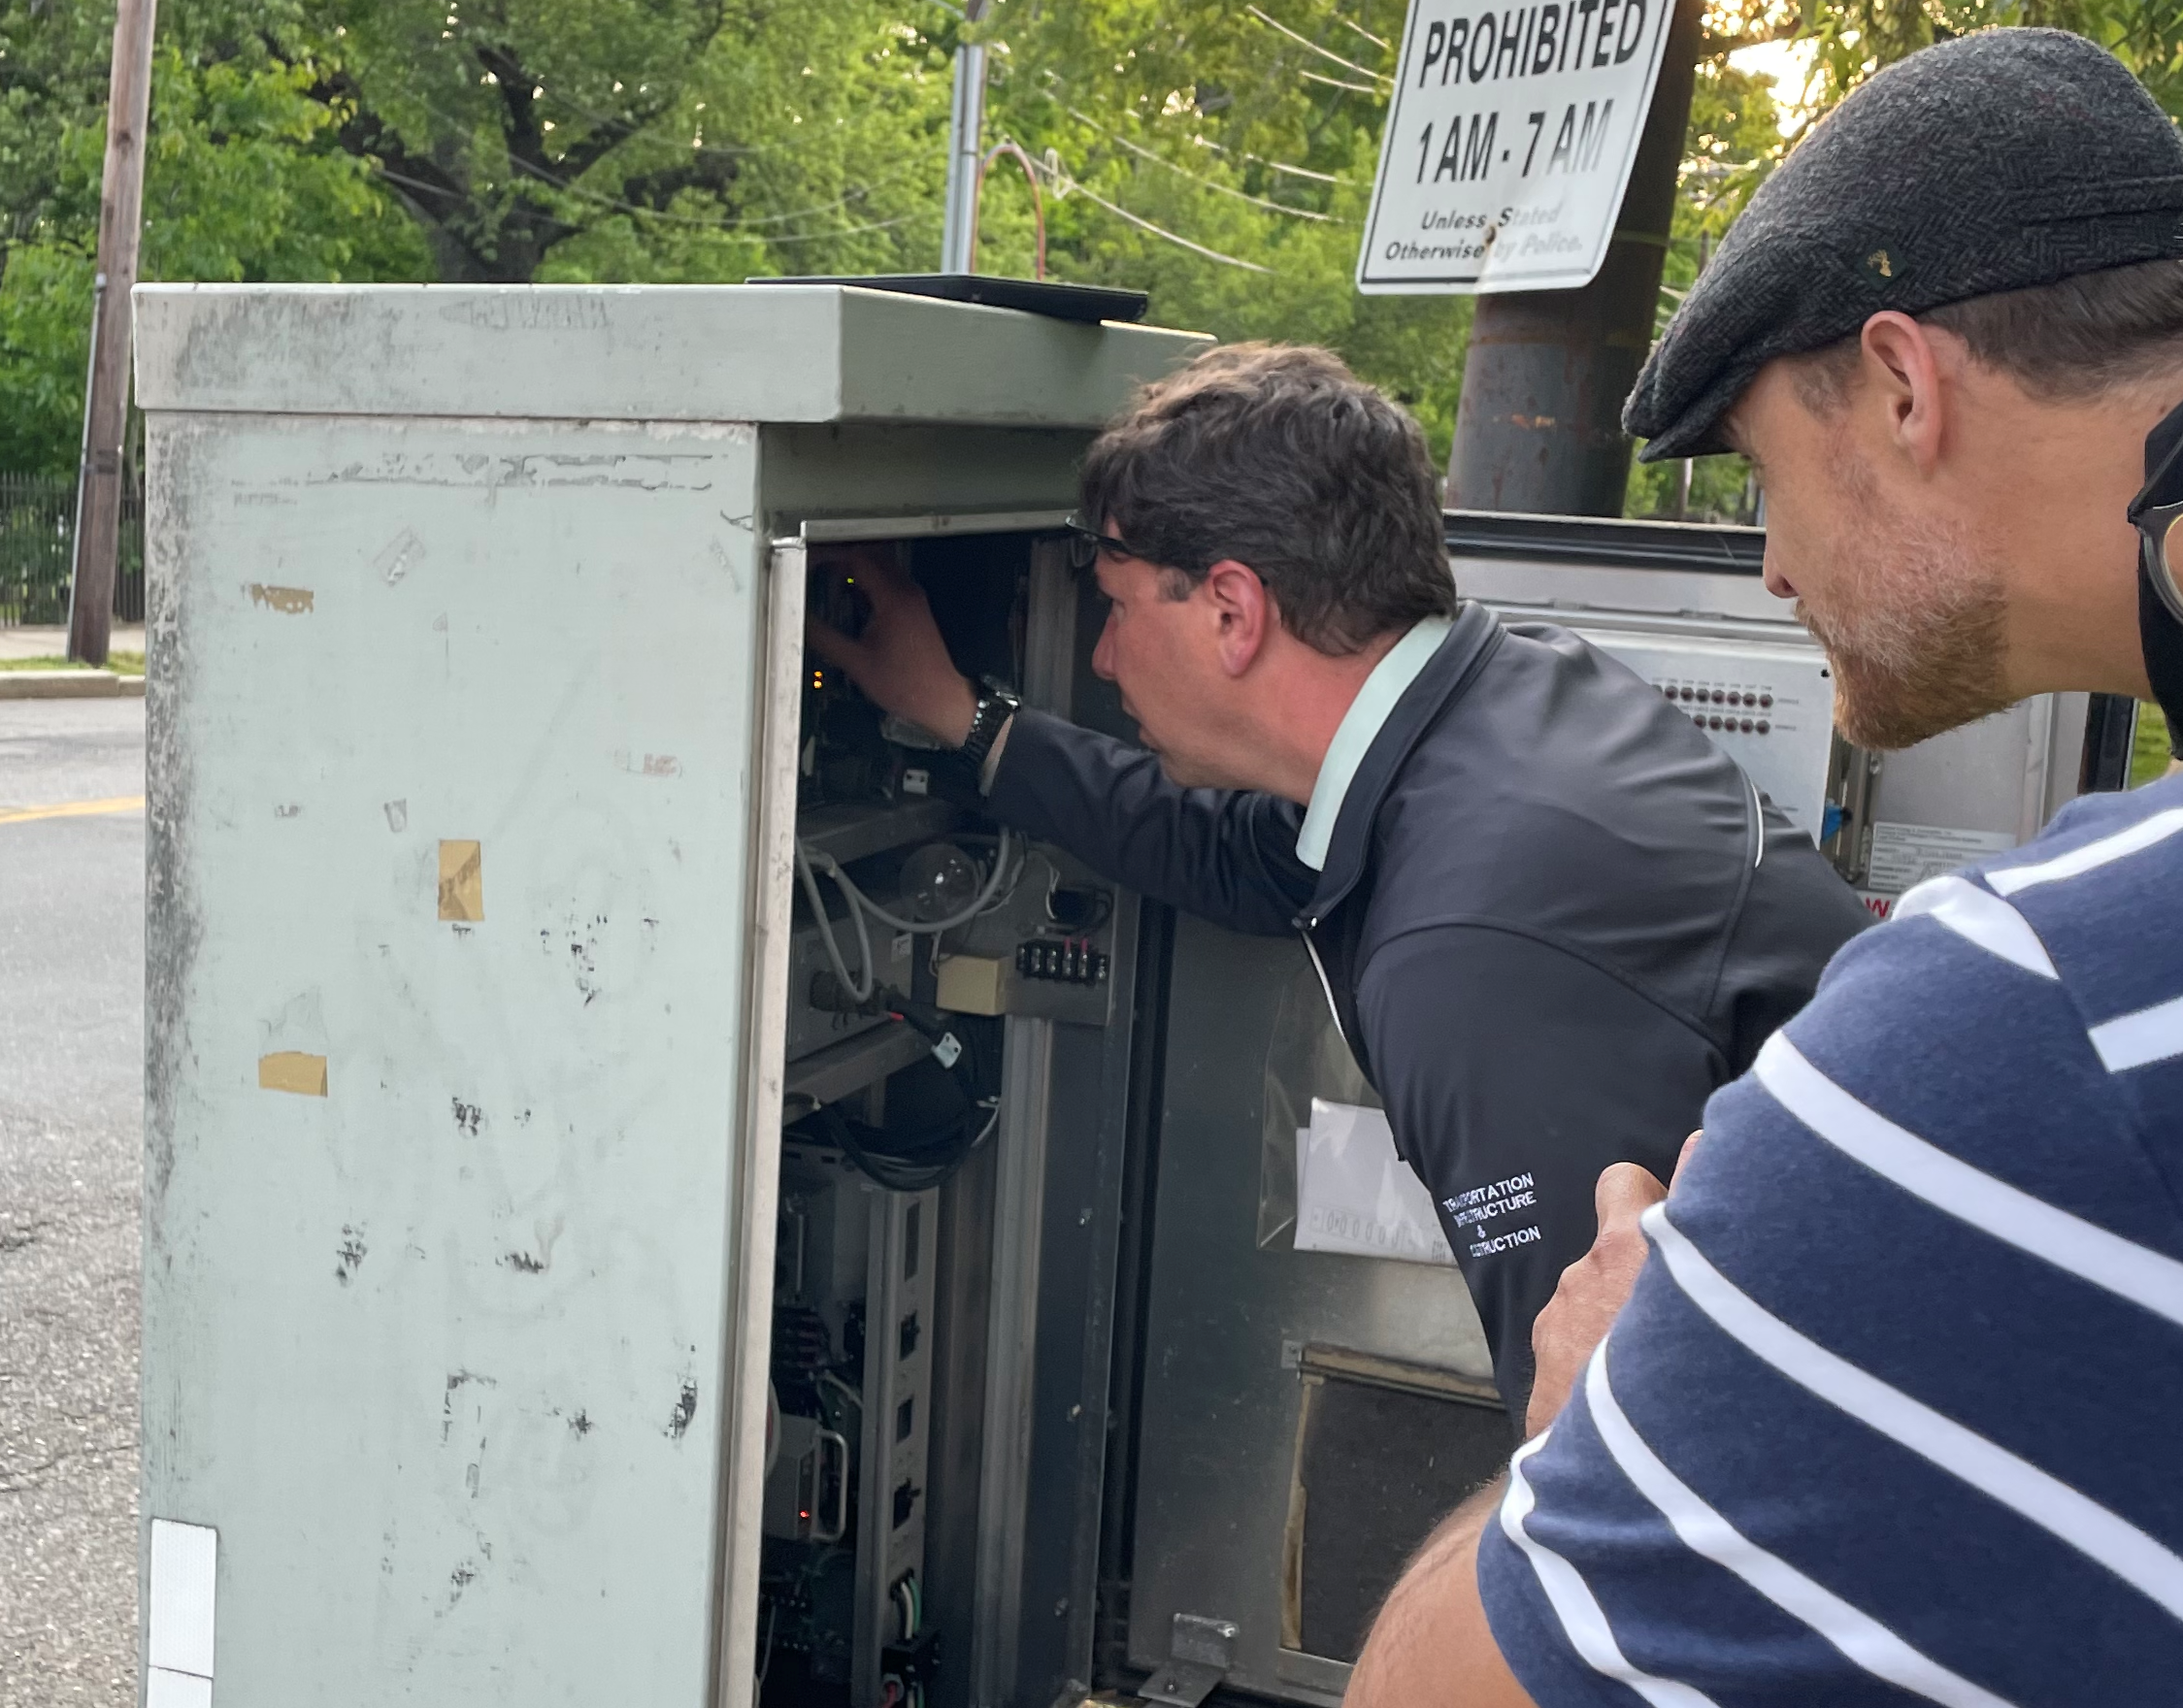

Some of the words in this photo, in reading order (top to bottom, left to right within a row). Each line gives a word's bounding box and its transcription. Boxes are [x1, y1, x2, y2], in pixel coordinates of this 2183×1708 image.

[1418, 0, 1647, 88] PROHIBITED
[1416, 121, 1434, 184] 1
[1434, 112, 1500, 183] AM
[1521, 112, 1546, 178] 7
[1547, 99, 1614, 176] AM
[1421, 210, 1487, 230] Unless
[1497, 202, 1562, 228] Stated
[1385, 238, 1486, 260] Otherwise
